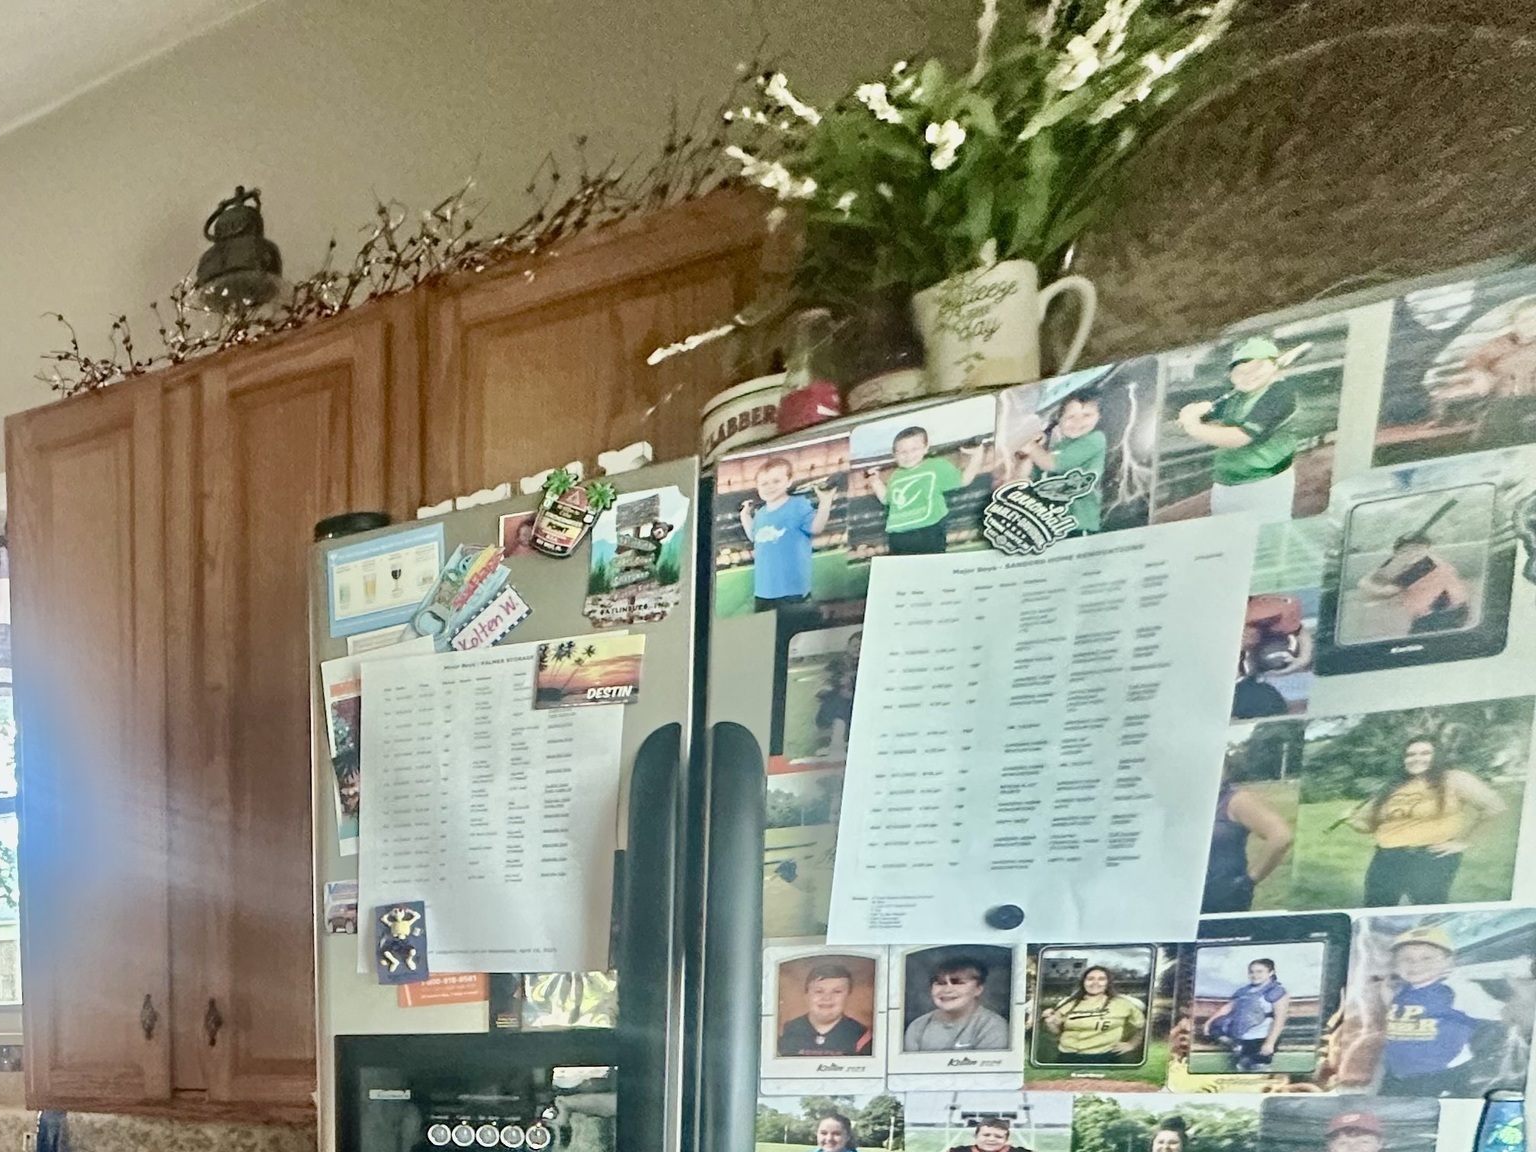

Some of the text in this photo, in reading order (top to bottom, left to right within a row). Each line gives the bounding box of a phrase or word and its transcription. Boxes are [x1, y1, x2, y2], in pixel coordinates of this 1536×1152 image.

[995, 481, 1077, 536] Cannonball
[457, 613, 504, 651] Kolten
[586, 684, 633, 700] DESTIN
[1094, 1020, 1111, 1032] 16
